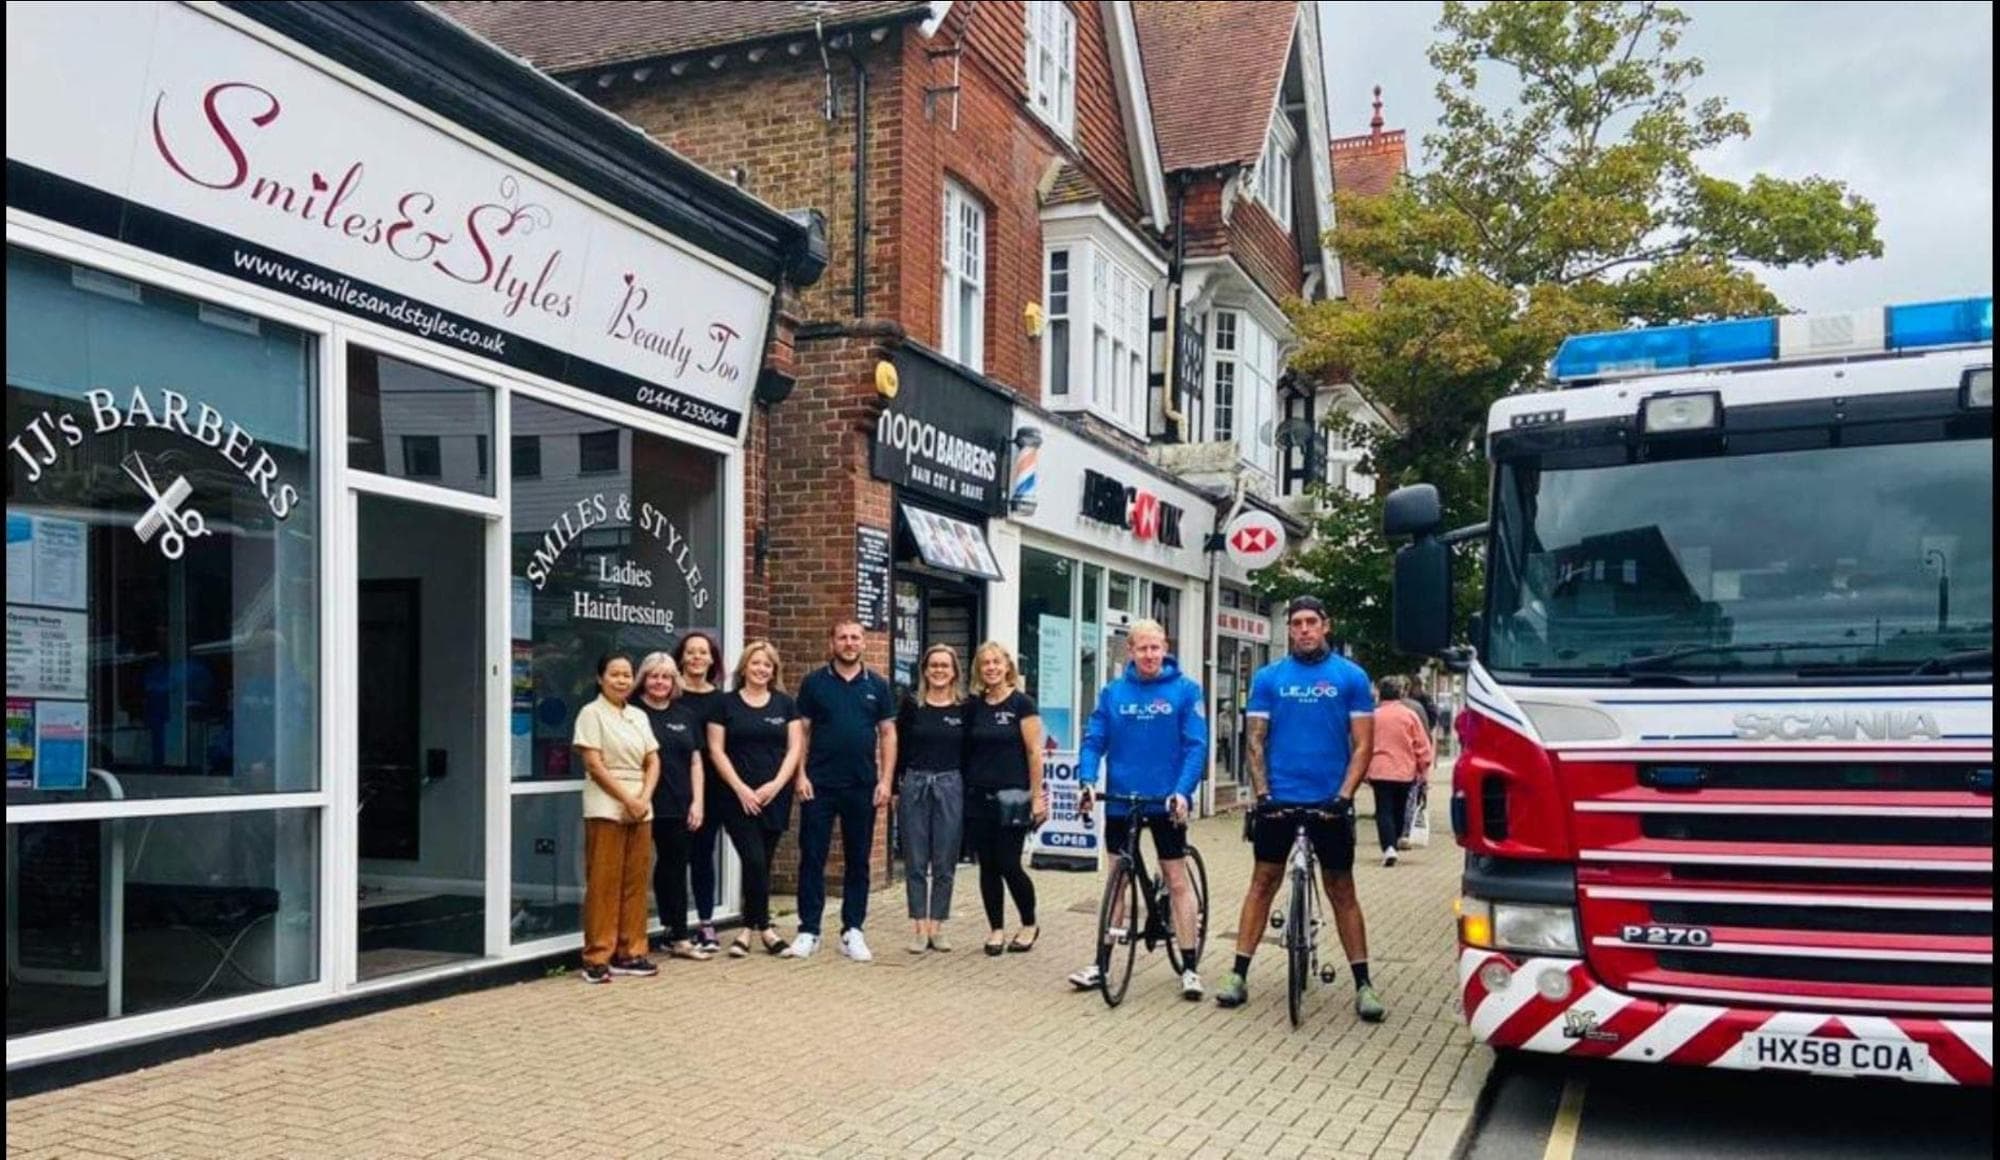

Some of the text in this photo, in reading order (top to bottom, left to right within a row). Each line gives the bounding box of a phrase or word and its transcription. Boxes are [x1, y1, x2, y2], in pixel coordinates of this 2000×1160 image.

[233, 250, 506, 354] www.smilesandstyles.co.uk
[609, 274, 740, 382] Beauty Too
[636, 386, 729, 429] 01444 233064
[8, 386, 299, 519] JJ's BARBERS
[878, 408, 997, 482] nopa BARBERS
[526, 493, 708, 610] SMILES & STYLES
[600, 557, 652, 588] Ladies
[573, 591, 674, 633] Hairdressing
[1120, 703, 1173, 715] LEJOG
[1280, 686, 1338, 698] LEJOG
[1734, 711, 1940, 741] SCANIA
[1050, 833, 1088, 848] OPEN
[1624, 926, 1709, 945] P 270
[1757, 1037, 1914, 1072] HX58 COA
